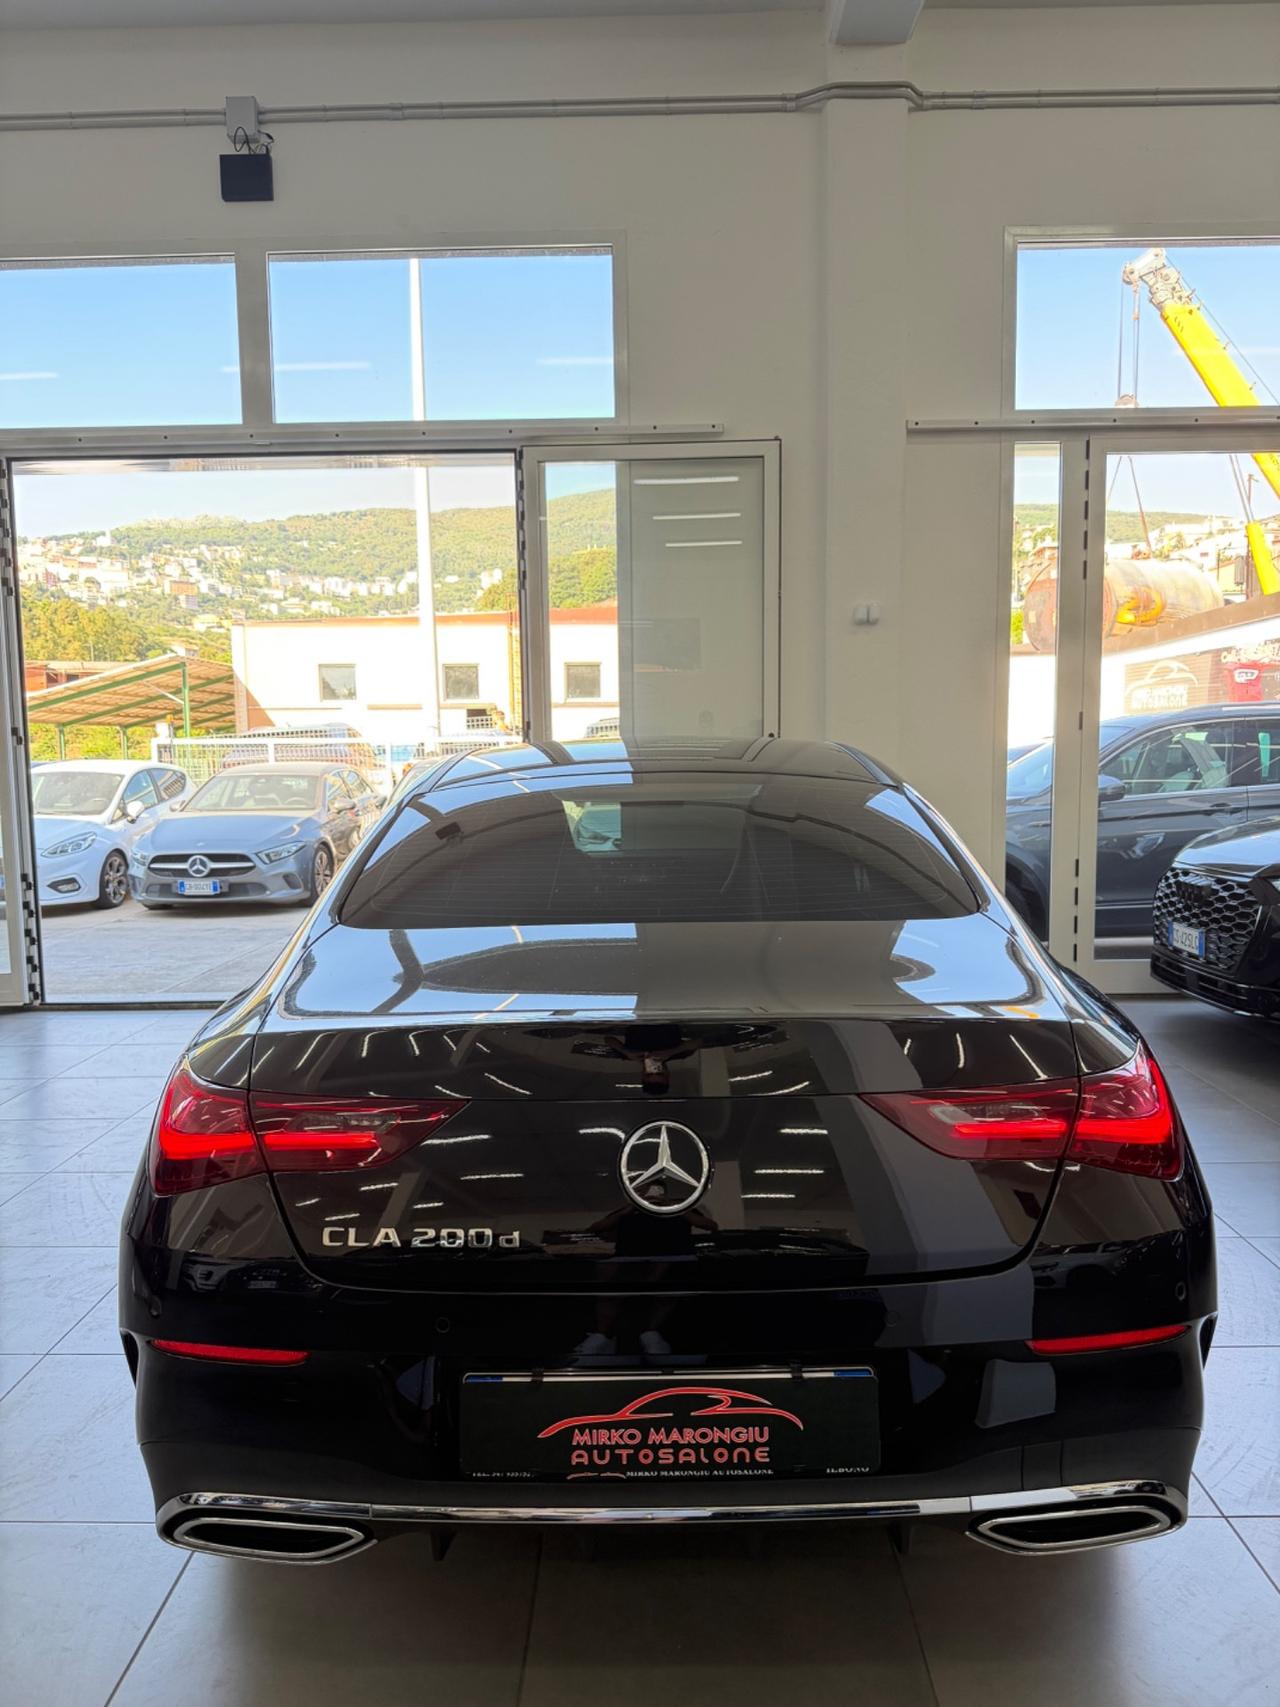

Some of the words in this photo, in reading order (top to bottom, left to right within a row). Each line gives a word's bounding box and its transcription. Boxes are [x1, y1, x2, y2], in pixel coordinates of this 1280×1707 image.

[321, 1227, 402, 1247] CLA
[571, 1427, 642, 1446] MIRKO
[647, 1426, 770, 1444] MARONGIU
[570, 1446, 771, 1466] AUTOSALONE
